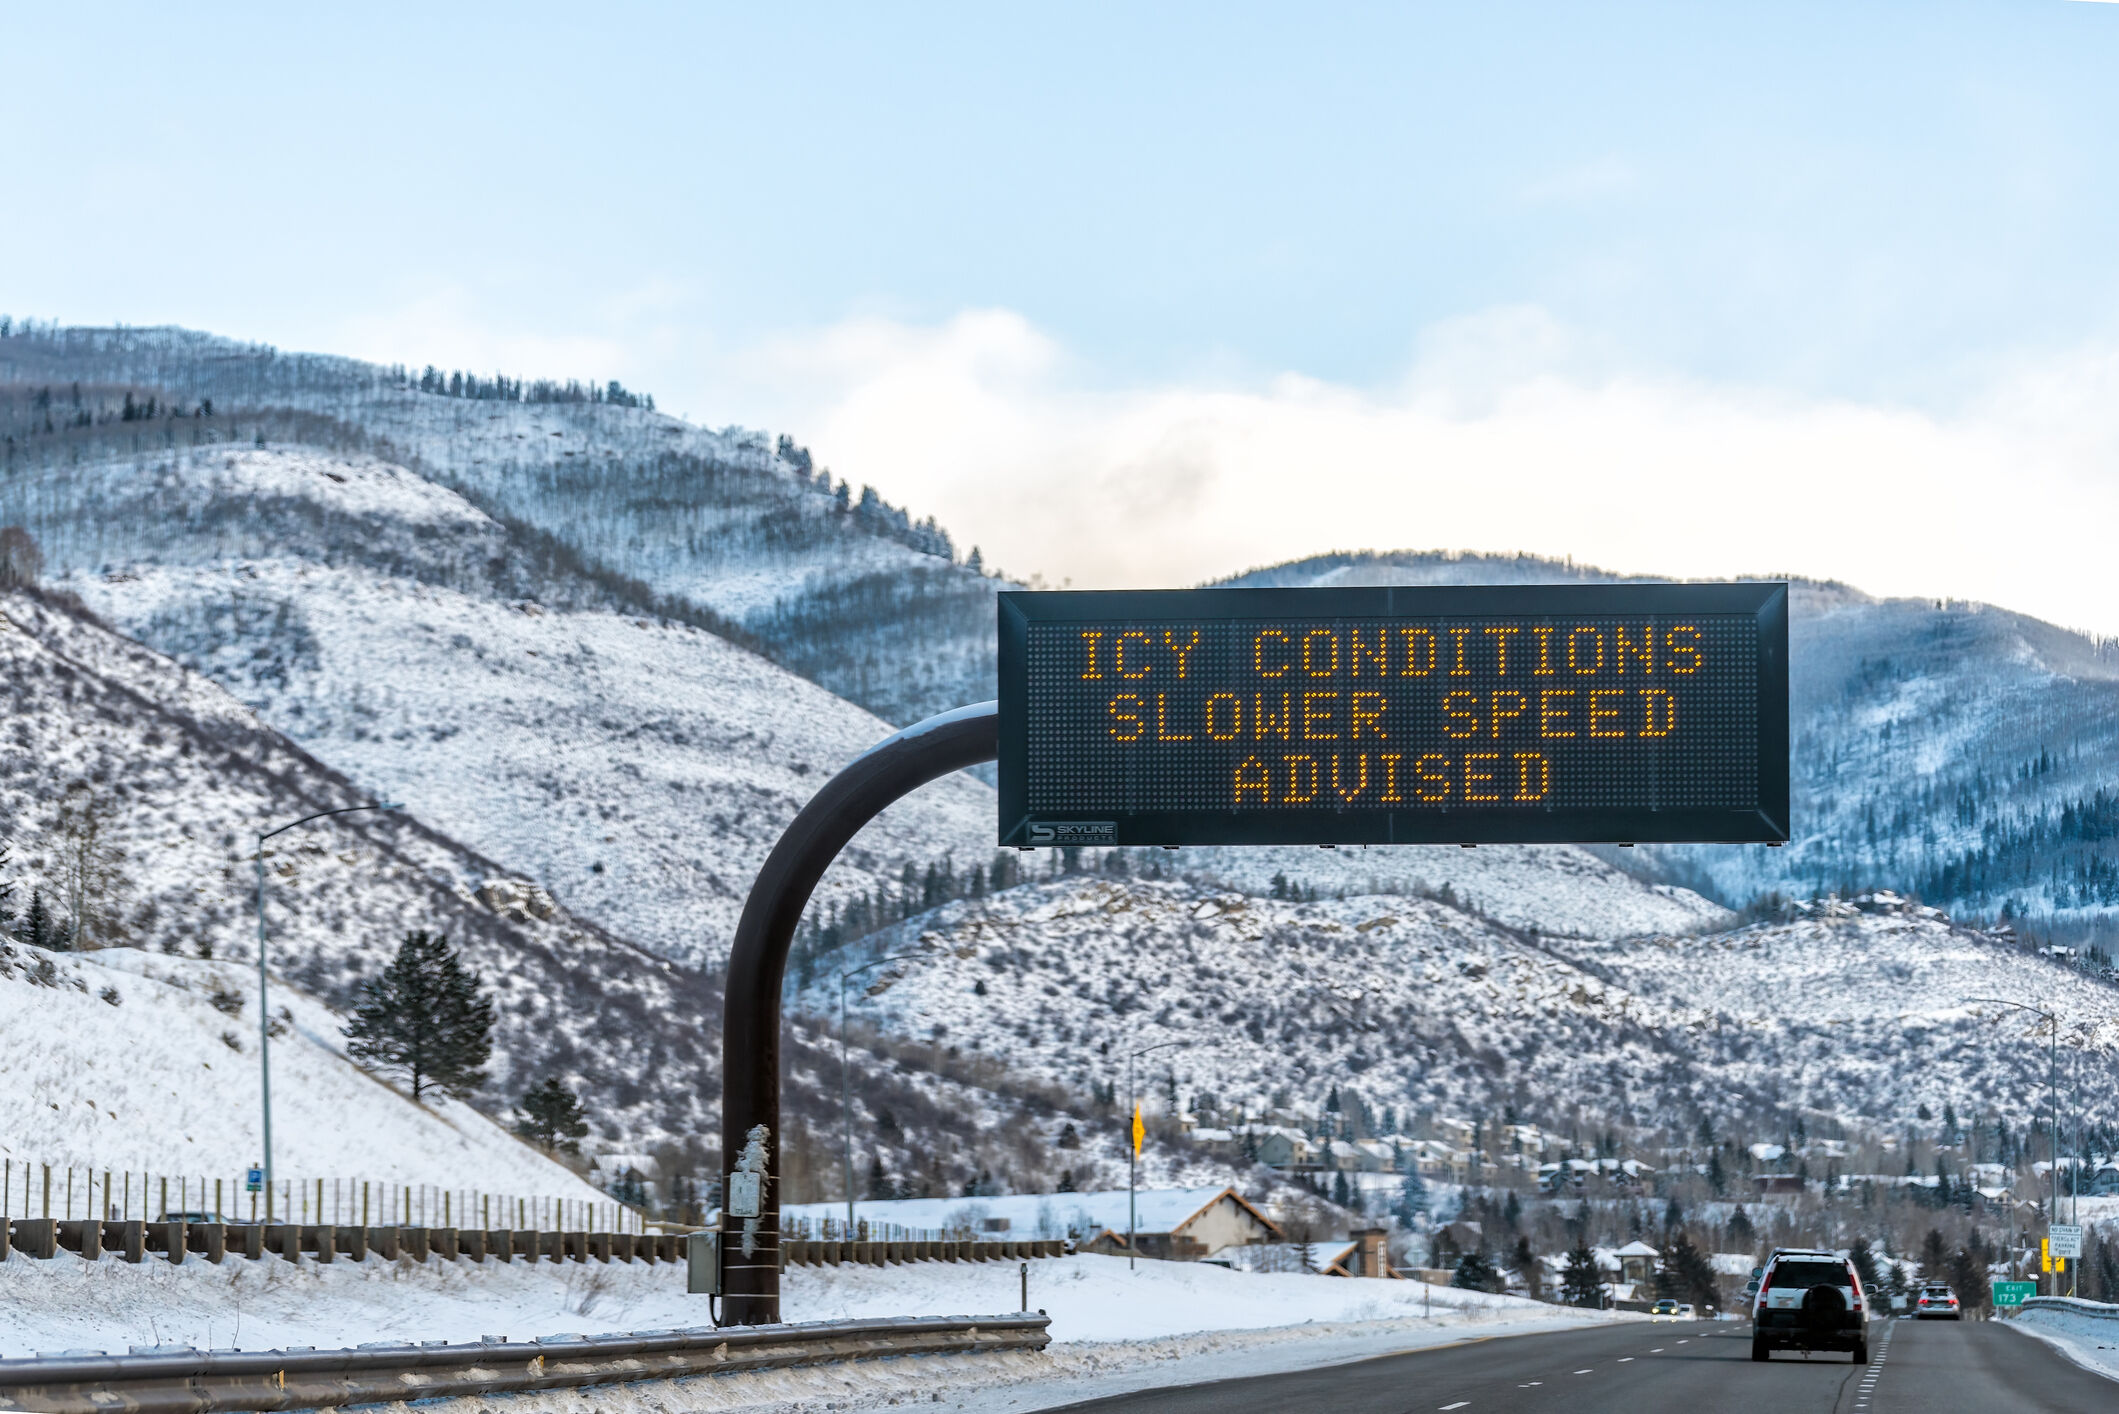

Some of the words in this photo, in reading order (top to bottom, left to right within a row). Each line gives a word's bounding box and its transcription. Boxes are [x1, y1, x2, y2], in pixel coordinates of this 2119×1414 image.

[1081, 630, 1199, 680] ICY
[1253, 625, 1703, 678] CONDITIONS
[1108, 691, 1389, 741] SLOWER
[1441, 688, 1676, 739] SPEED
[1233, 752, 1550, 803] ADVISED
[1057, 825, 1114, 834] SKYLINE
[1998, 1293, 2016, 1303] 173
[2006, 1284, 2022, 1292] EXIT
